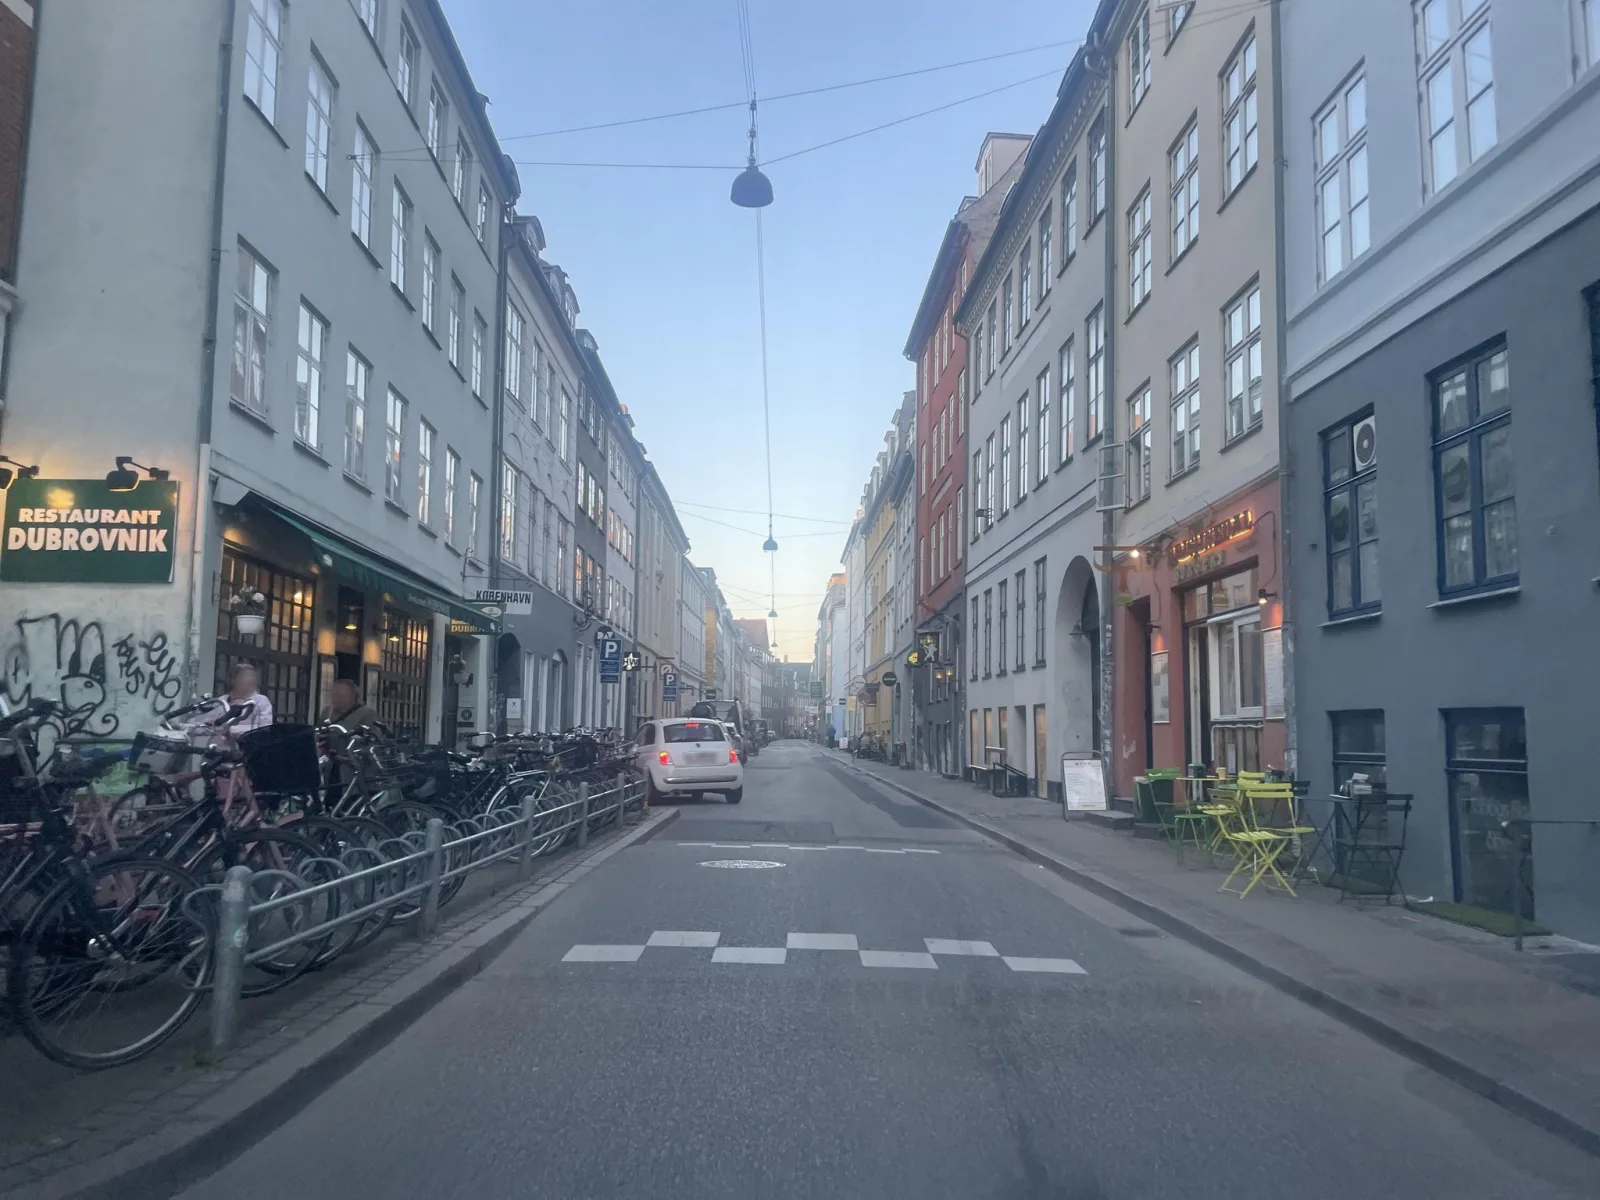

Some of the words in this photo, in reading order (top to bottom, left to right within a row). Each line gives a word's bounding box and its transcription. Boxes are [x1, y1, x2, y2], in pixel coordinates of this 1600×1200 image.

[19, 508, 161, 524] RESTAURANT
[7, 527, 168, 552] DUBROVNIK
[605, 642, 618, 658] P
[666, 675, 674, 686] P
